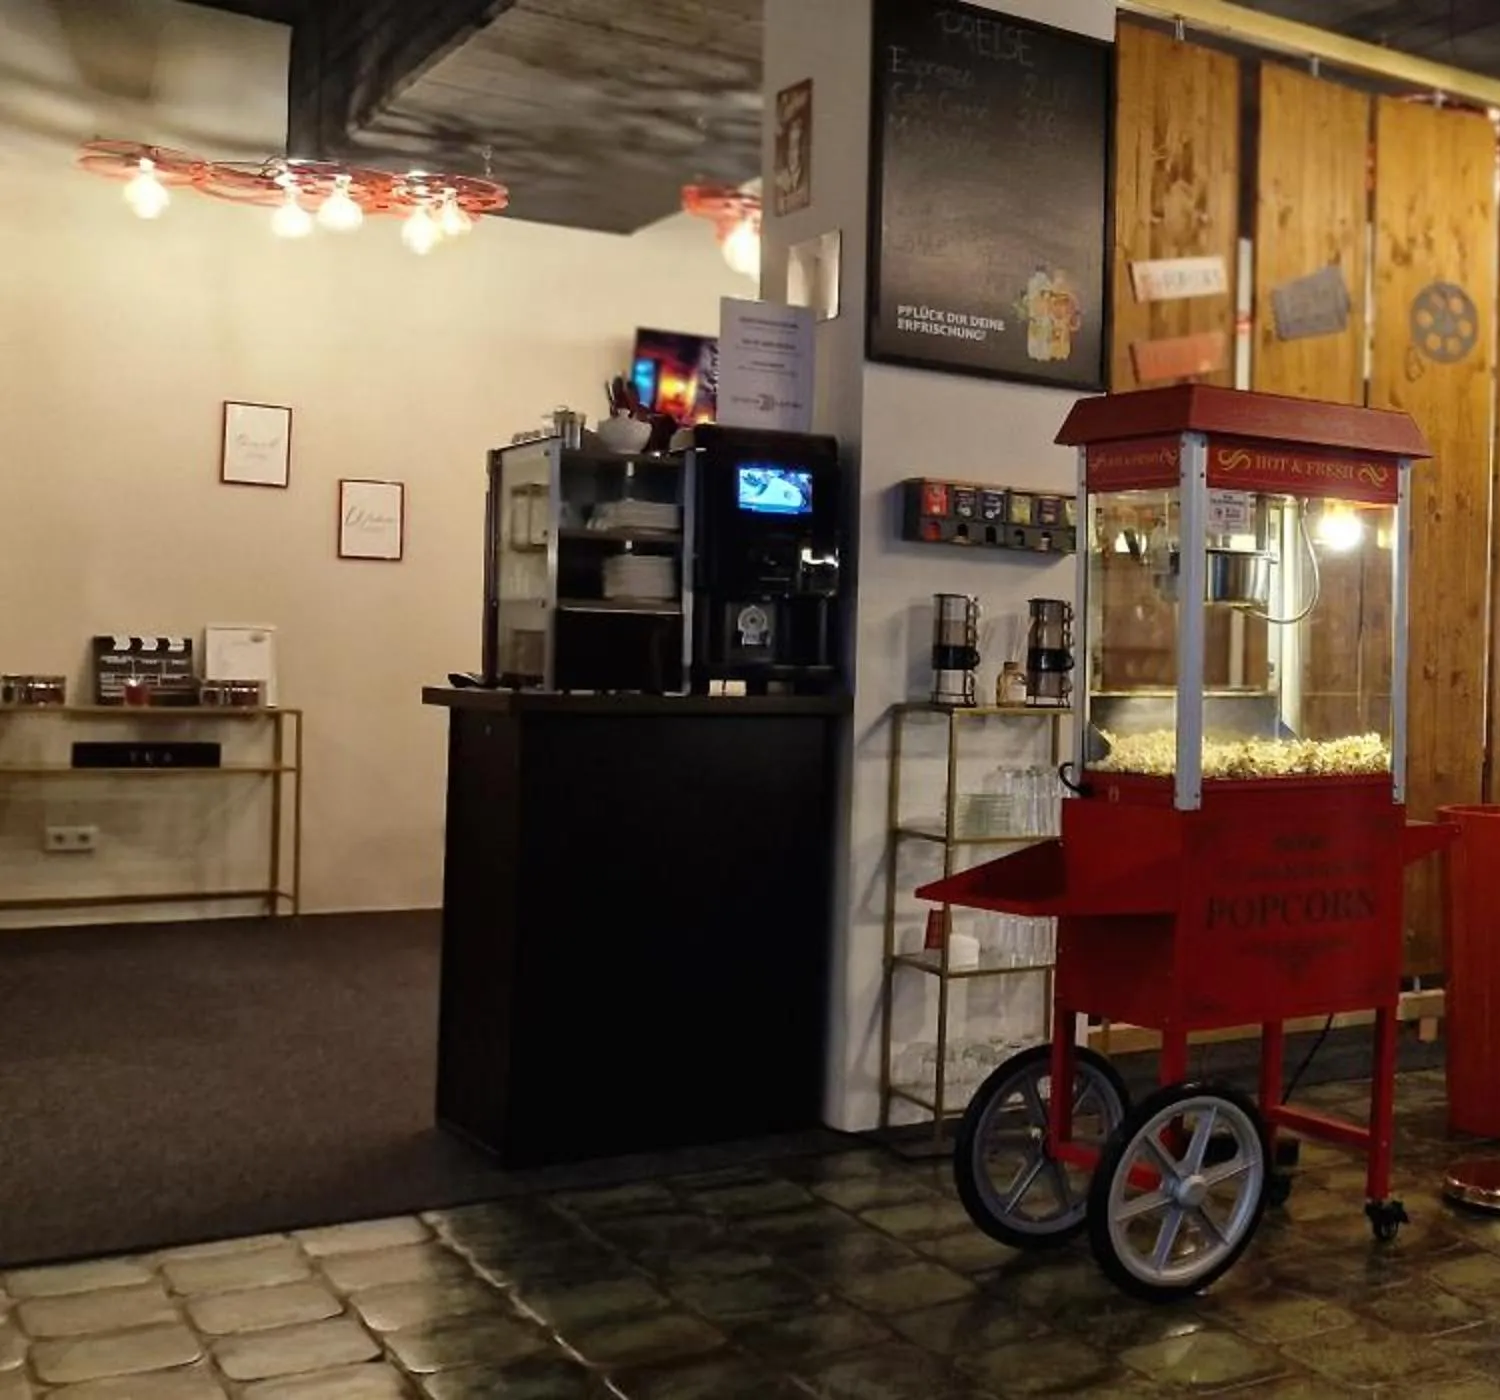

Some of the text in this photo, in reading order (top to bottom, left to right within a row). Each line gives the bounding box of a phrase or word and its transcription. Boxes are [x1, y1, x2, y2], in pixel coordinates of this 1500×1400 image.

[898, 304, 1005, 331] PFLÜCK DIR DEINE
[1256, 455, 1288, 471] HOT
[1306, 461, 1354, 480] FRESH
[1206, 886, 1376, 931] POPCORN
